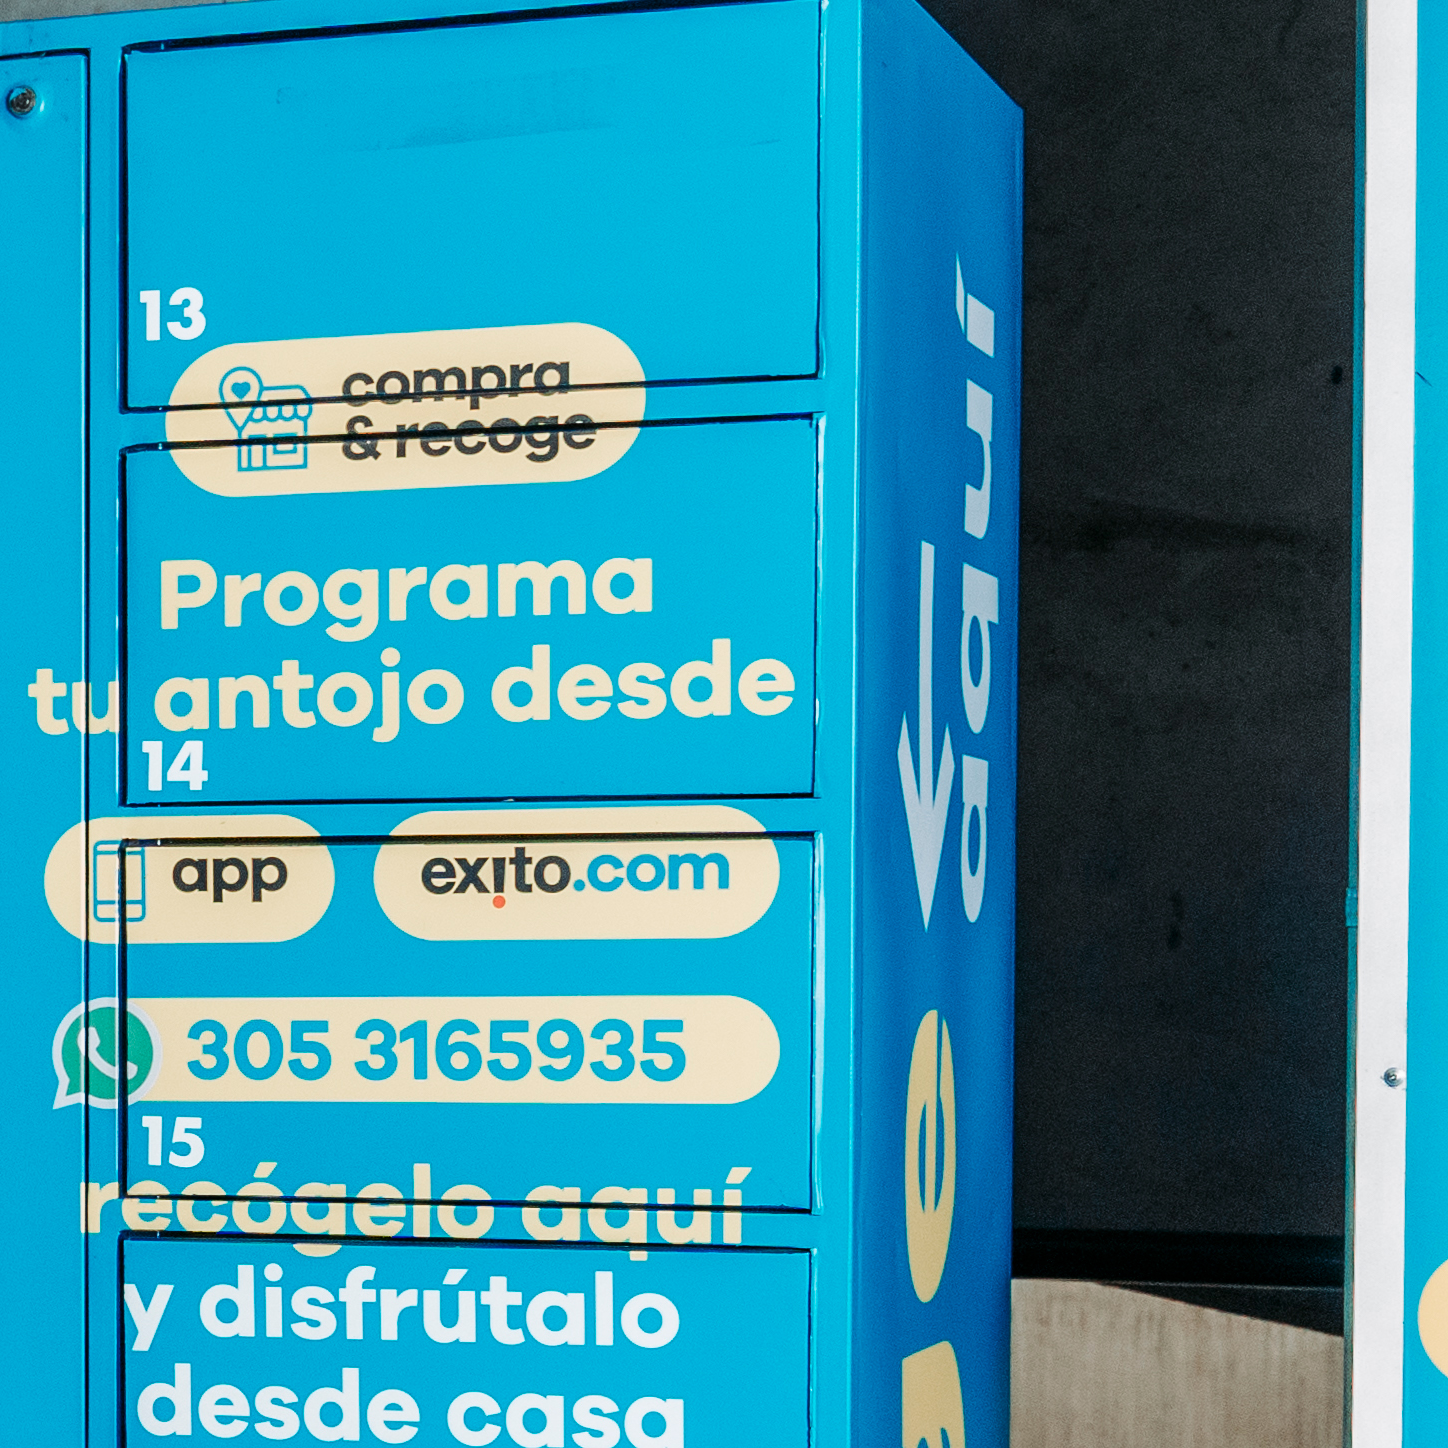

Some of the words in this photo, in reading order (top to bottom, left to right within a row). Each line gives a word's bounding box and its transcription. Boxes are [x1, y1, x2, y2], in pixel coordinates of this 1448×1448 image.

[139, 287, 207, 342] 13
[341, 356, 570, 410] compra
[341, 414, 382, 464] &
[396, 408, 597, 463] recoge
[159, 556, 653, 643] Programa
[956, 250, 1000, 925] aquí
[28, 668, 120, 736] tu
[154, 647, 464, 744] antojo
[491, 638, 796, 724] desde
[141, 740, 208, 792] 14
[172, 853, 289, 903] app
[420, 846, 731, 910] exito.com
[186, 1019, 333, 1081] 305
[353, 1019, 687, 1082] 3165935
[141, 1115, 205, 1169] 15
[79, 1161, 495, 1258] recógelo
[521, 1166, 753, 1262] aquí
[123, 1281, 174, 1352] y
[199, 1262, 681, 1349] disfrútalo
[137, 1363, 421, 1444] desde
